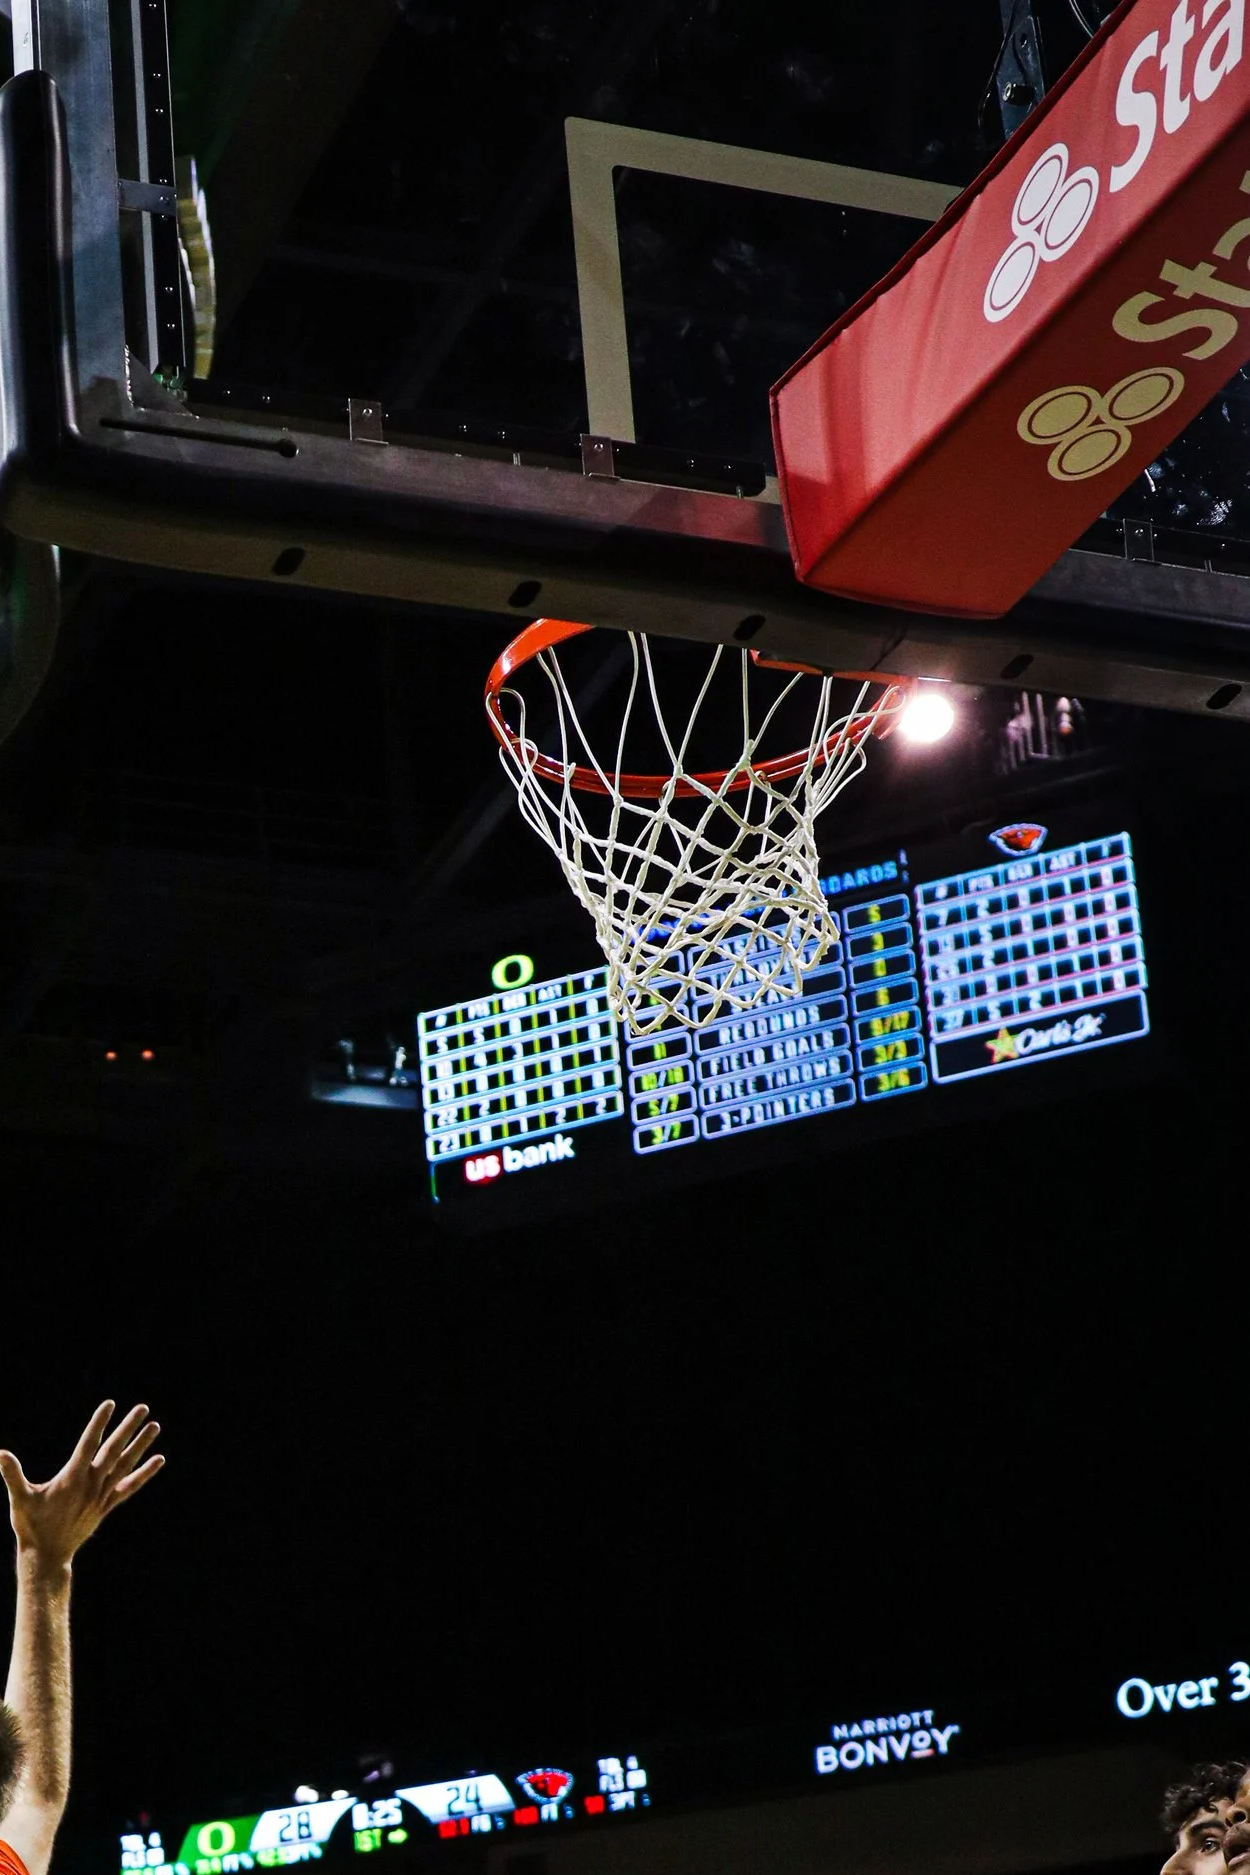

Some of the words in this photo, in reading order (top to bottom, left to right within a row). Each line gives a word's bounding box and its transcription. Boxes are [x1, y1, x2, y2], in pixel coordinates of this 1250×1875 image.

[1109, 0, 1246, 194] Sta
[718, 1004, 820, 1046] REBOUNDS
[709, 1046, 766, 1077] FIELD
[771, 1029, 835, 1061] GOALS
[708, 1076, 758, 1105] FREE
[764, 1055, 842, 1090] THROWS
[720, 1086, 836, 1132] 3-POINTERS
[1116, 1677, 1218, 1719] Over
[833, 1709, 934, 1741] MARRIOTT
[814, 1725, 959, 1776] BONVOY
[446, 1783, 481, 1817] 24
[278, 1811, 312, 1843] 28
